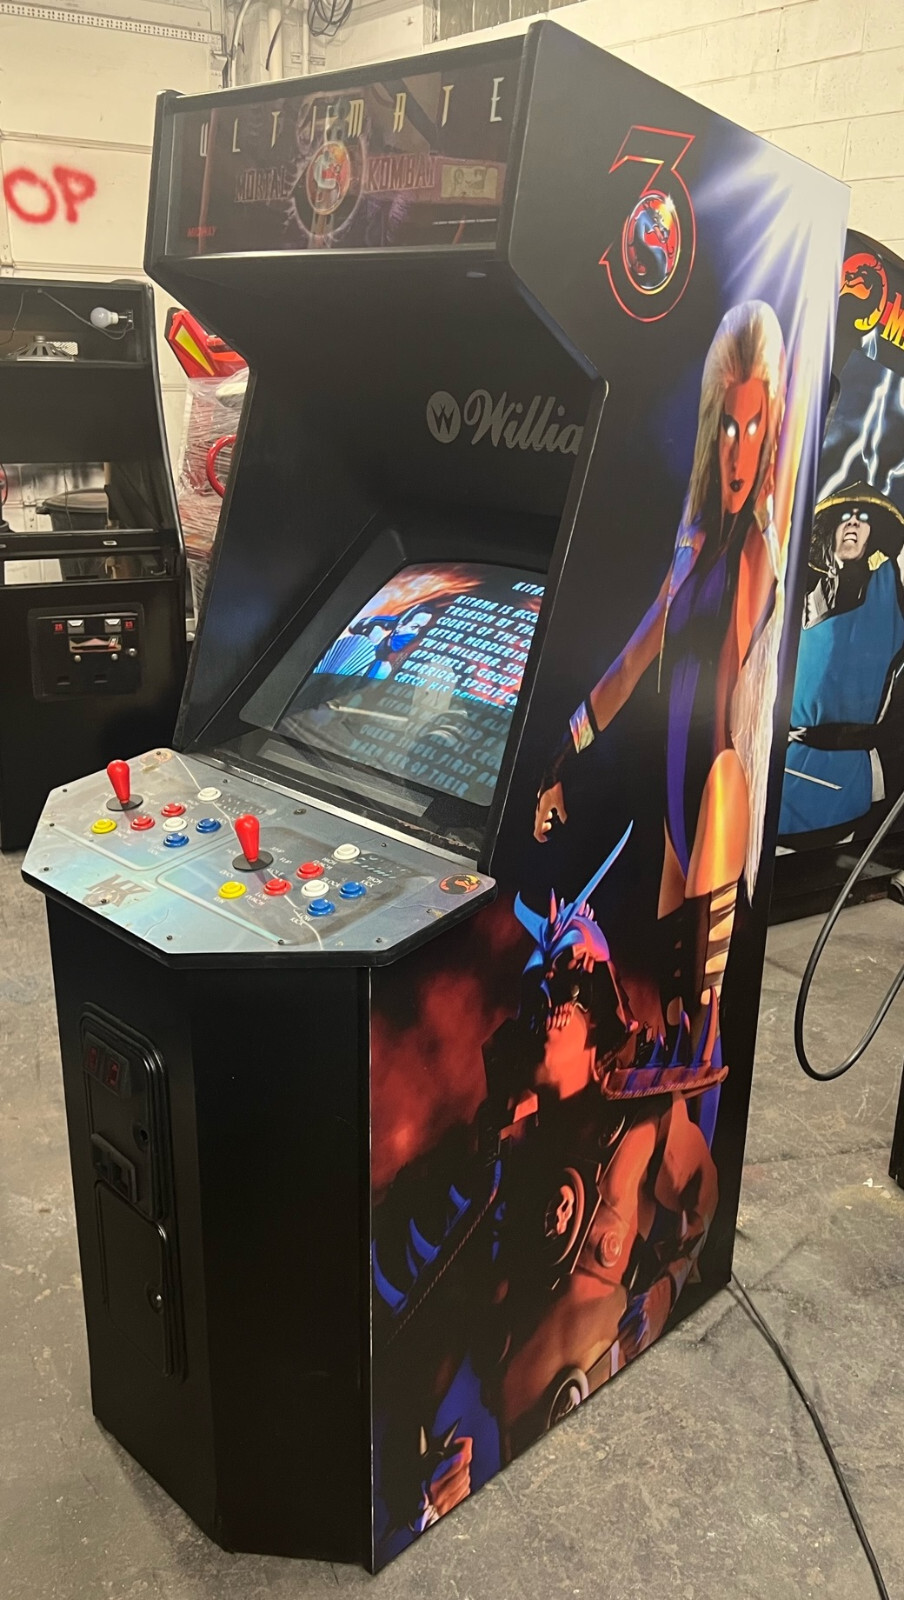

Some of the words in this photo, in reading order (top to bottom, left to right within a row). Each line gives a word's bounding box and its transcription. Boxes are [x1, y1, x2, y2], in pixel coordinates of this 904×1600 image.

[200, 76, 505, 157] ULTIMATE
[366, 153, 437, 194] KOMBAT
[3, 164, 96, 226] OP
[445, 605, 496, 624] TREASON
[495, 617, 515, 629] BY
[454, 595, 499, 611] KITANA
[497, 605, 514, 615] IS
[426, 627, 464, 643] AFTER
[436, 616, 477, 632] COURTS
[476, 626, 494, 637] OF
[493, 630, 520, 644] THE
[419, 637, 449, 652] TWIN
[394, 671, 427, 687] CATCH
[401, 659, 462, 684] WARRIORS
[409, 649, 466, 671] APPOINTS
[463, 664, 477, 674] A
[476, 668, 519, 687] GROUP
